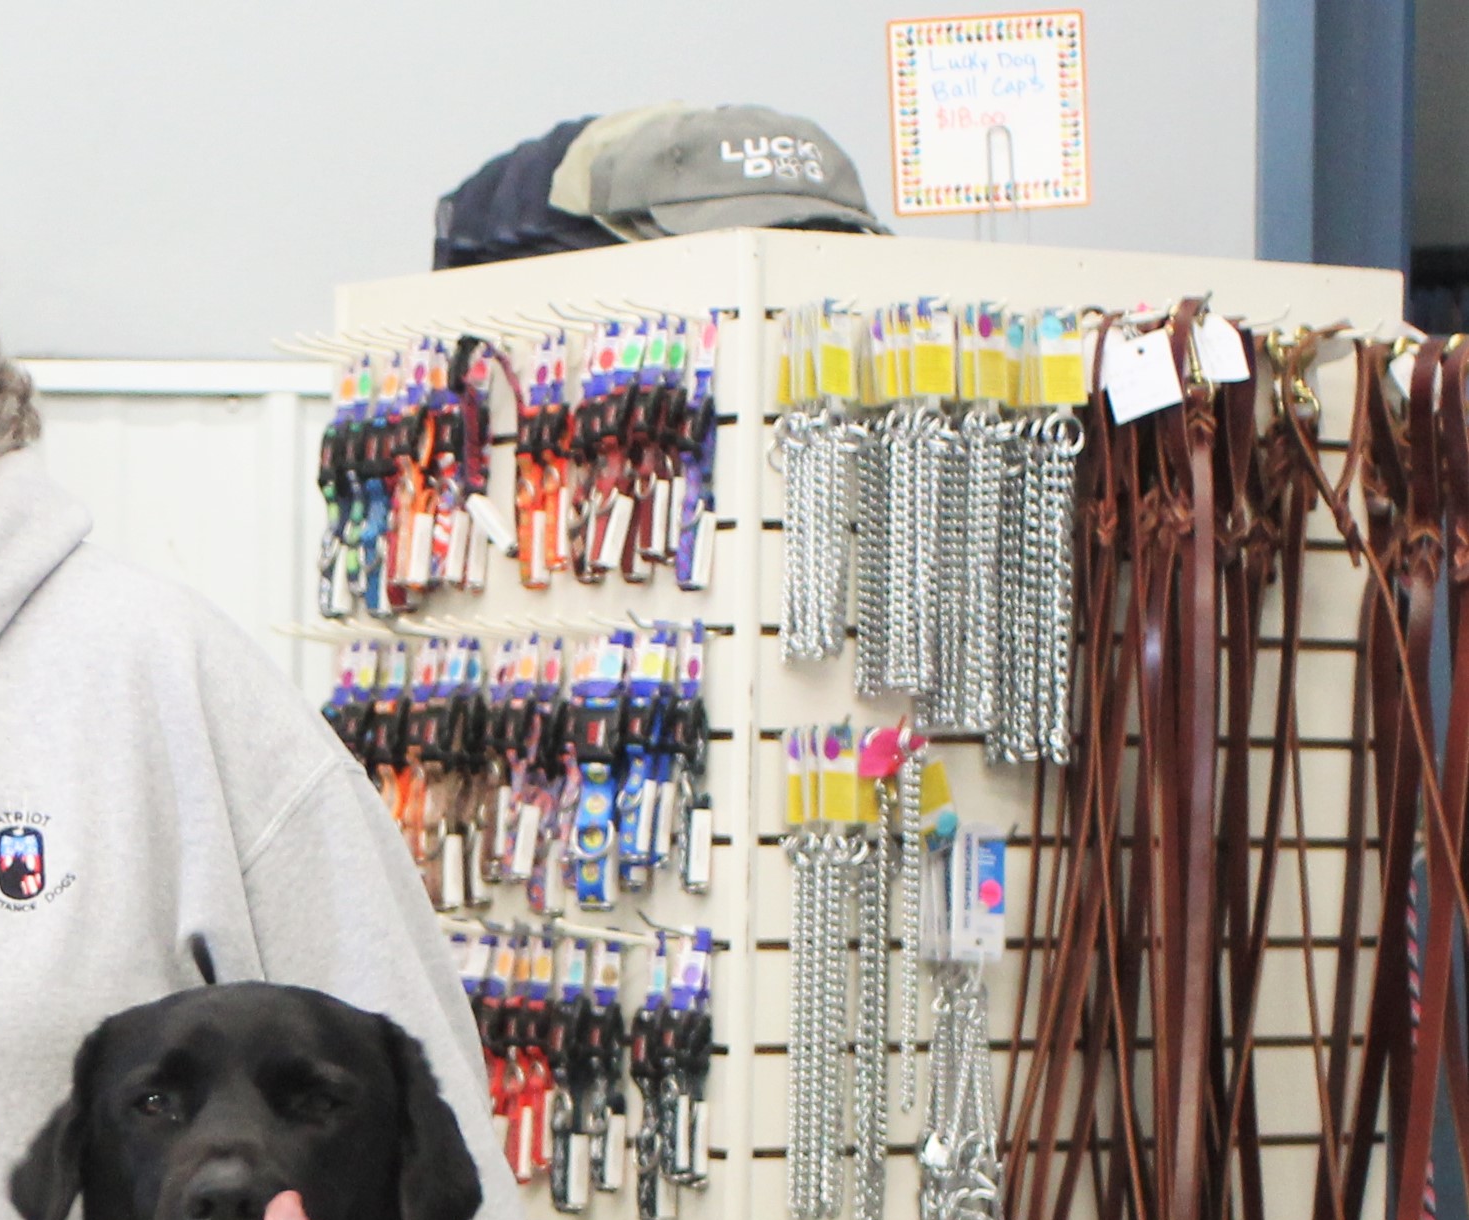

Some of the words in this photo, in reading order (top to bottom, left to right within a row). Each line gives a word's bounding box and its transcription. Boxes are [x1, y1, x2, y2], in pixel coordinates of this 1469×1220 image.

[929, 49, 988, 74] Lucky
[996, 51, 1038, 77] Dog
[931, 76, 978, 102] Ball
[935, 105, 1006, 130] $18.00
[44, 872, 77, 903] DOGS
